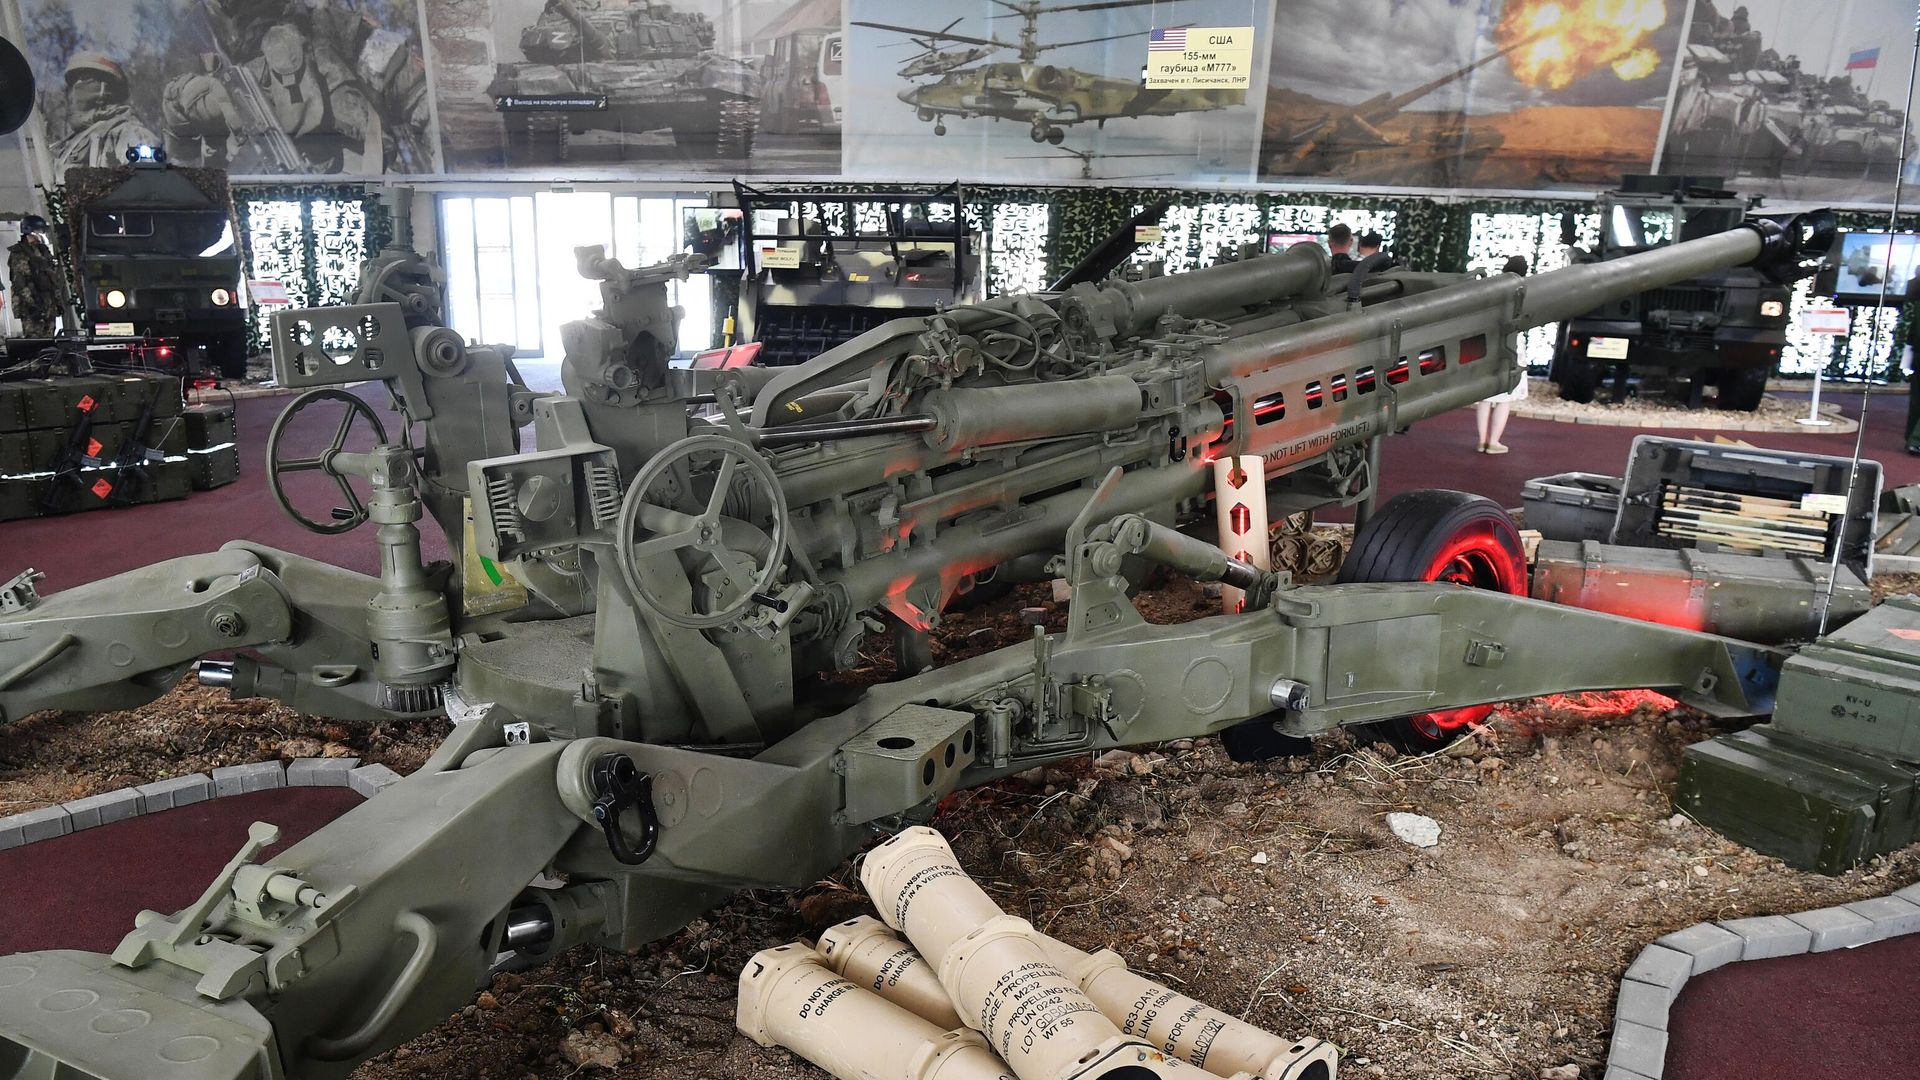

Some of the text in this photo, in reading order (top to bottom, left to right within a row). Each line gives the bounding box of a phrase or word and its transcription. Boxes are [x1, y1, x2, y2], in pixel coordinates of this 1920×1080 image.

[551, 32, 567, 43] Z
[1209, 36, 1233, 44] США
[1160, 63, 1237, 74] гаубица «М777»
[1183, 52, 1216, 60] 155-мм
[1270, 448, 1288, 463] NOT
[1290, 441, 1307, 456] LIFT
[1308, 434, 1329, 447] WITH
[898, 865, 939, 902] TRANSPORT
[908, 890, 916, 899] IN
[874, 975, 884, 990] DO
[880, 958, 896, 975] NOT
[888, 957, 916, 986] CHARGE
[799, 1004, 811, 1019] DO
[808, 987, 825, 1004] NOT
[815, 988, 846, 1016] CHARGE
[1014, 981, 1042, 1001] M232
[1008, 987, 1063, 1028] PROPELLING
[1021, 996, 1063, 1026] UN 0242
[1020, 1027, 1037, 1054] LOT
[1042, 1018, 1074, 1040] WT 55
[1168, 1022, 1186, 1042] FOR
